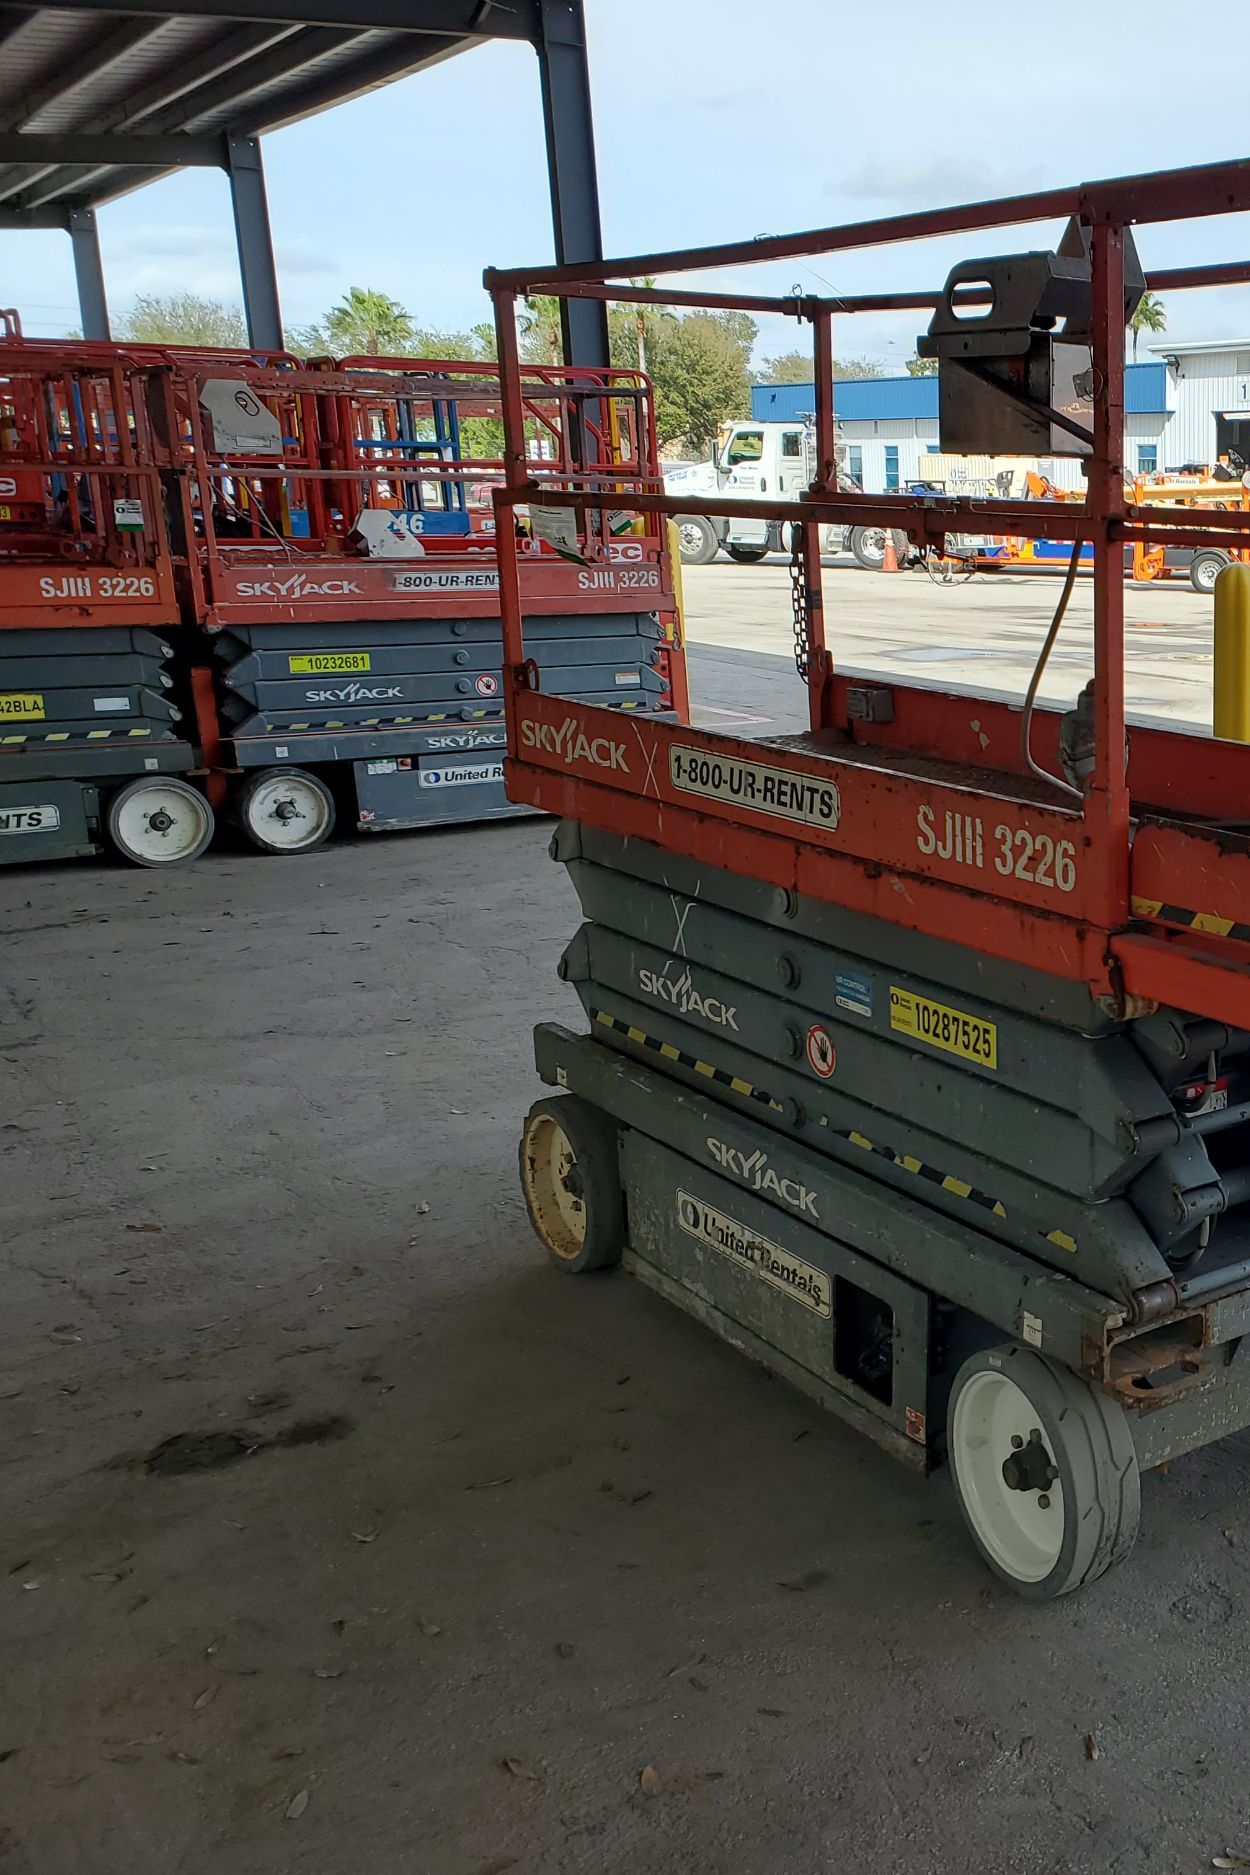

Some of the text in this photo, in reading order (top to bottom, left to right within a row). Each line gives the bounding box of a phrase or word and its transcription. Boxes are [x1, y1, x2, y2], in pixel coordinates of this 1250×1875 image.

[1241, 383, 1247, 400] 1
[98, 577, 155, 597] 3226
[236, 574, 364, 598] SKYJACK
[619, 571, 659, 588] 3226
[307, 656, 366, 670] 10232681
[305, 682, 404, 703] SKYJACK
[521, 718, 631, 773] SKYJACK
[444, 768, 489, 782] United
[673, 754, 834, 819] 1-800-UR-RENTS
[995, 825, 1076, 891] 3226
[640, 970, 739, 1031] SKYJACK
[915, 1002, 991, 1059] 10287525
[706, 1137, 820, 1219] SKYJACK
[703, 1212, 757, 1265] United
